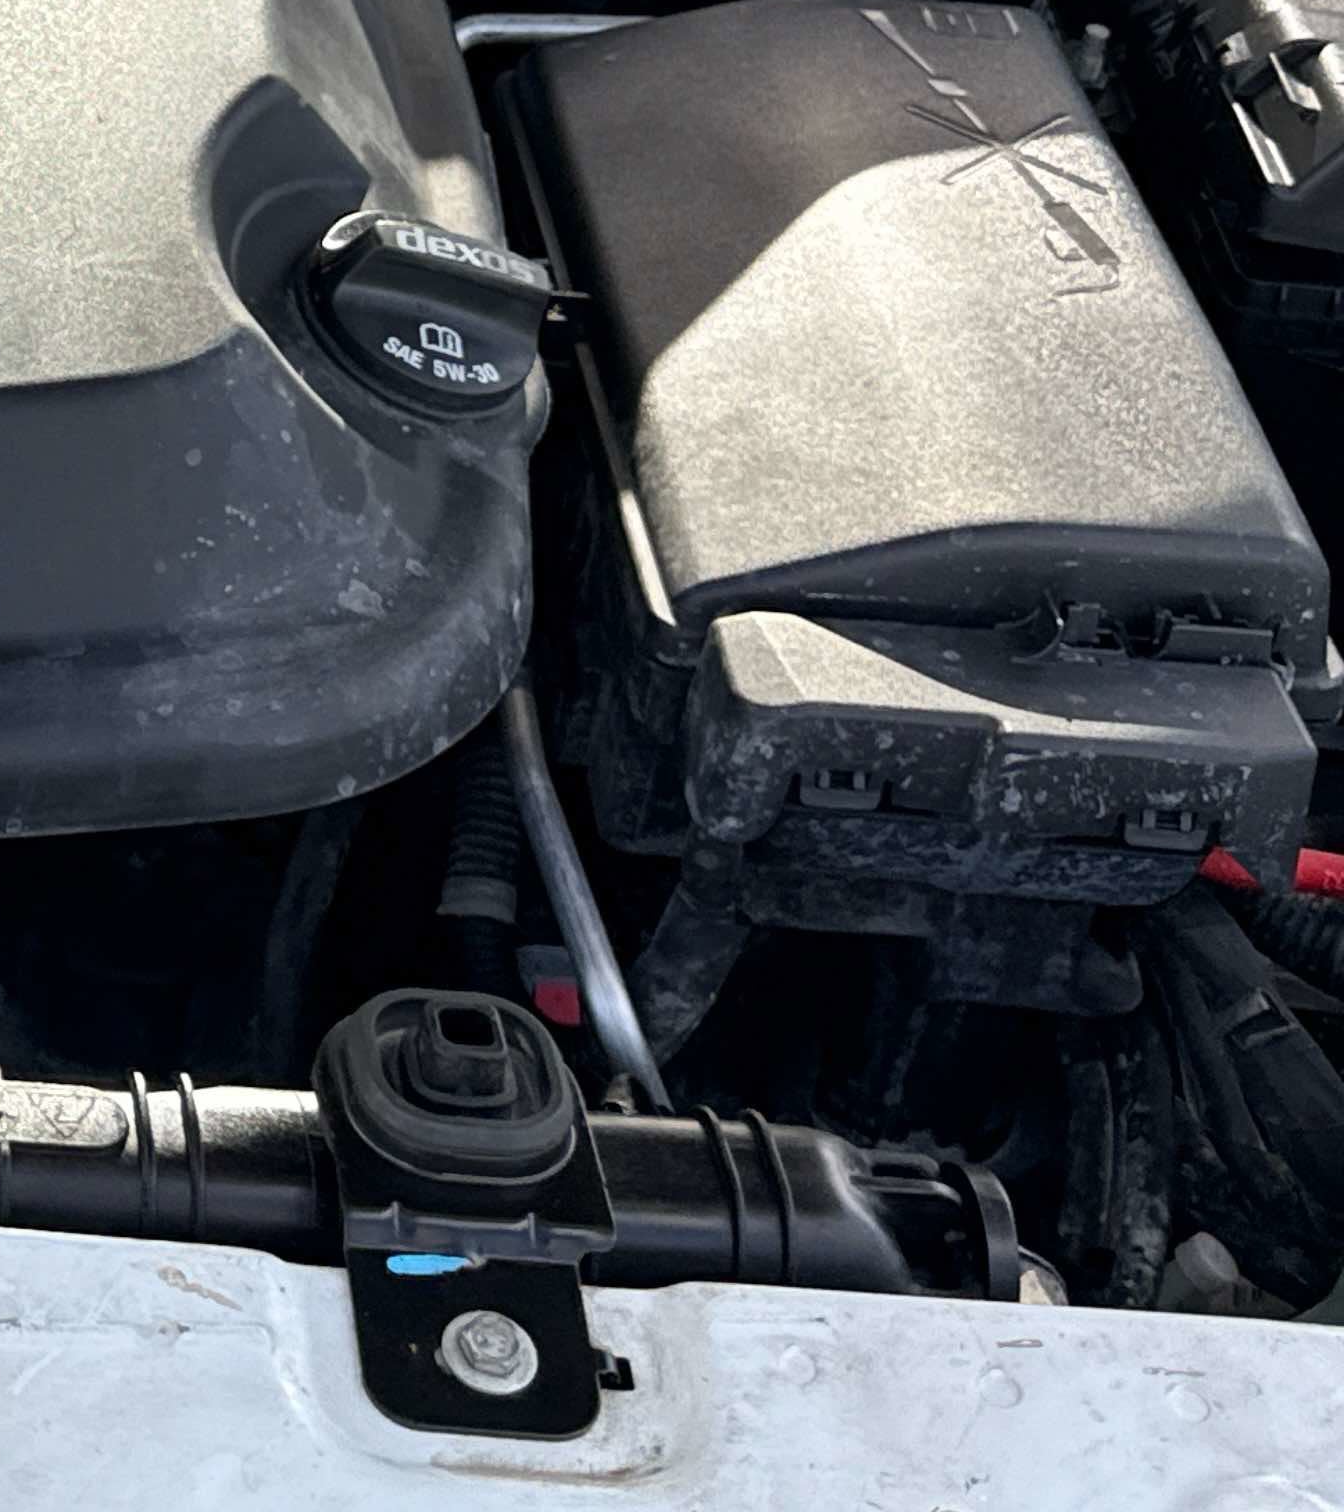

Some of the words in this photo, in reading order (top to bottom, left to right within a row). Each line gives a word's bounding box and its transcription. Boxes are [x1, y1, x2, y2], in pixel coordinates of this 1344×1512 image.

[395, 228, 534, 284] dexos
[383, 337, 425, 370] SAE
[433, 360, 500, 384] 5W-30
